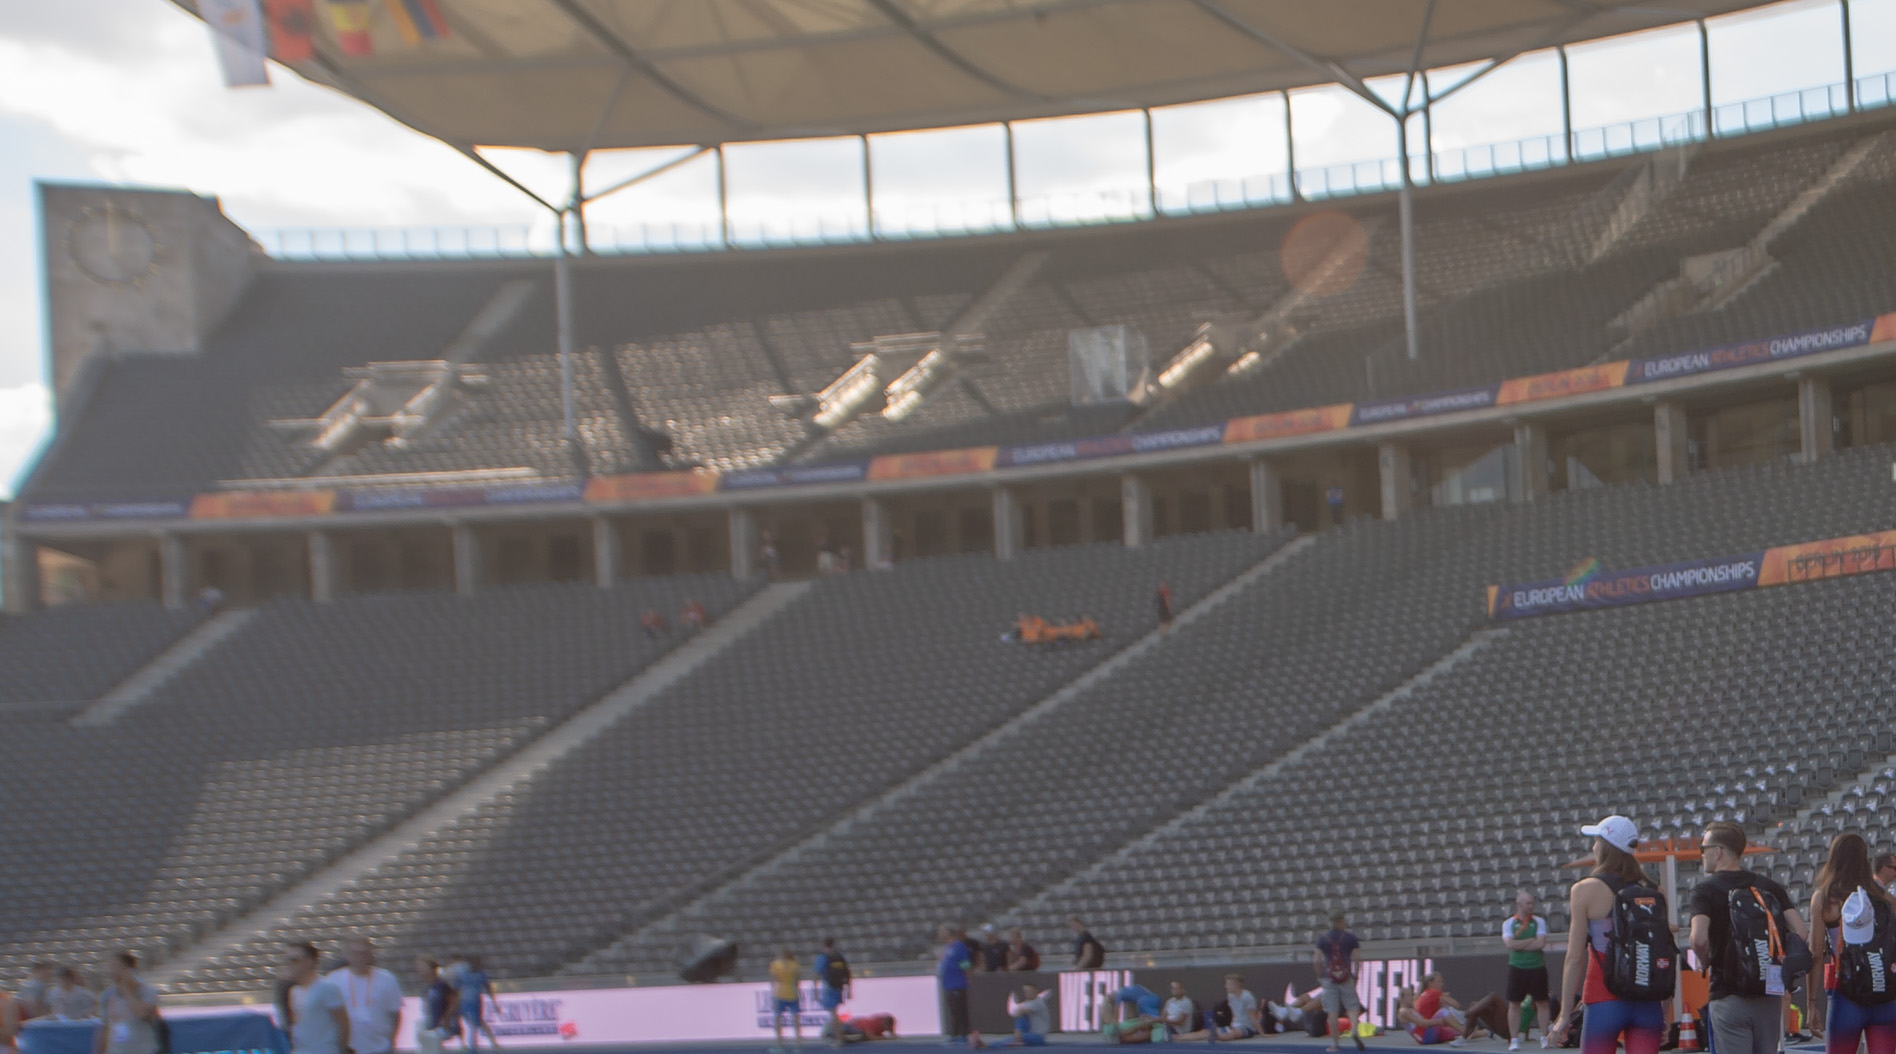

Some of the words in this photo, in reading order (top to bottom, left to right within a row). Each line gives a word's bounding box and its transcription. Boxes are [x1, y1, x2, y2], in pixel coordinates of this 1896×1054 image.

[1644, 352, 1710, 377] EUROPEAN
[1770, 324, 1867, 355] CHAMPIONSHIPS
[1513, 585, 1585, 608] EUROPEAN
[1650, 560, 1755, 591] CHAMPIONSHIPS
[1635, 940, 1650, 987] NORWAY
[1866, 951, 1886, 993] NORWAY
